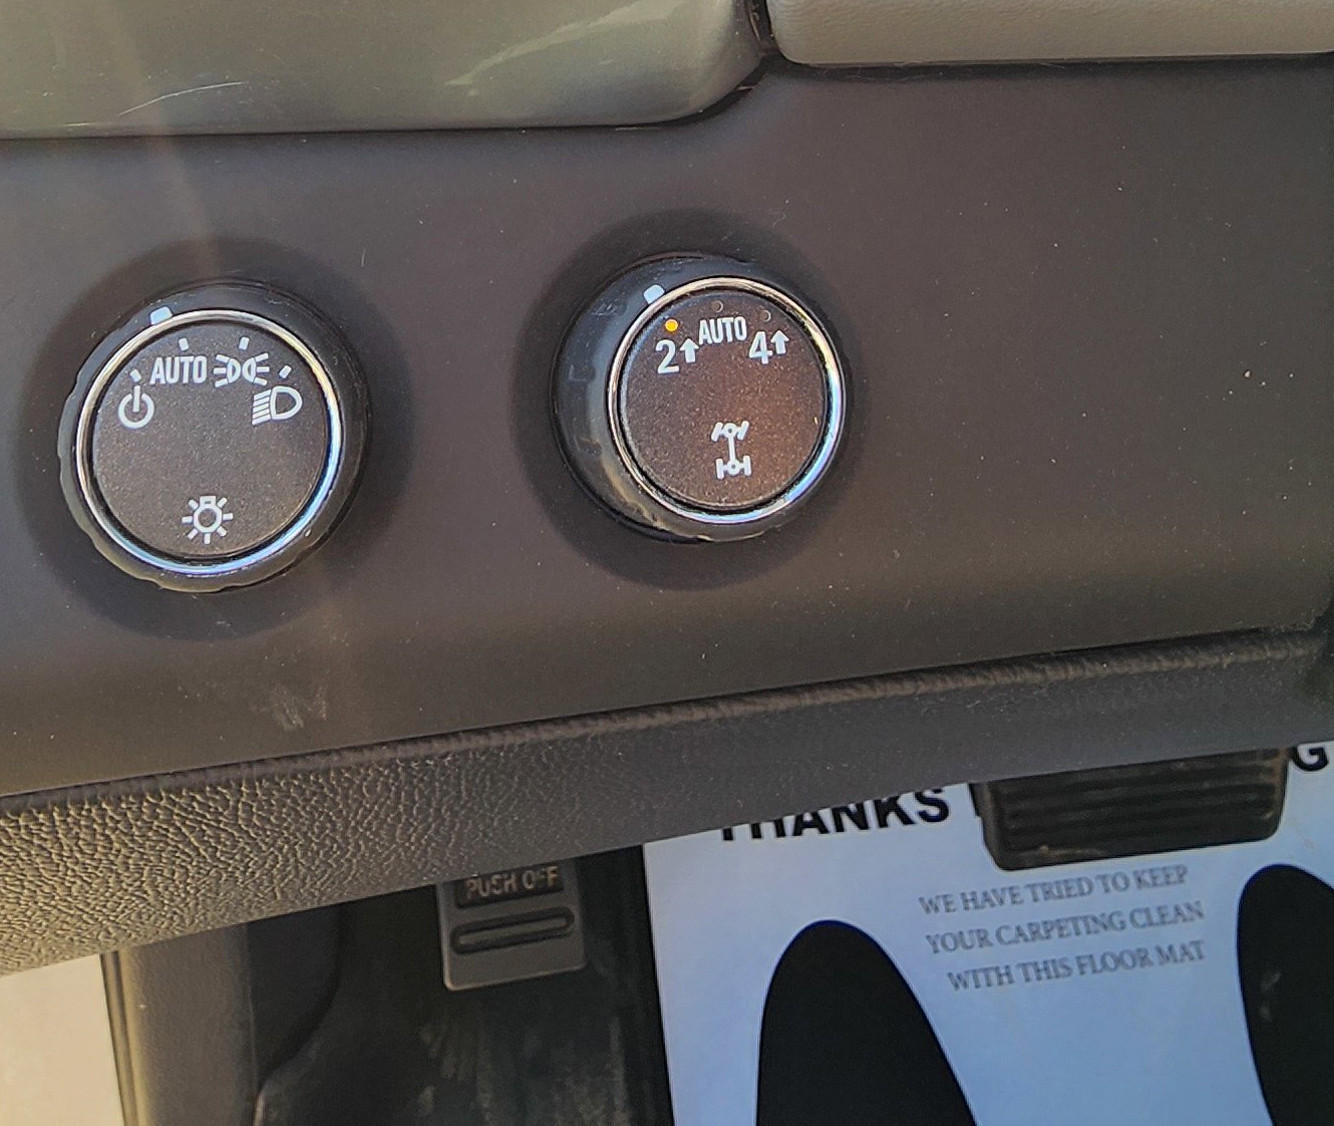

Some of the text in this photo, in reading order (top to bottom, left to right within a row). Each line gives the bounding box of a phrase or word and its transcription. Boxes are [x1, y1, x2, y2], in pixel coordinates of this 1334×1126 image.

[699, 316, 748, 346] AUTO
[748, 330, 774, 365] 4
[149, 355, 208, 385] AUTO
[655, 338, 680, 374] 2
[467, 873, 517, 902] PUSH
[918, 864, 1188, 915] WE HAVE TRIED TO KEEP
[925, 900, 1204, 954] YOUR CARPETING CLEAN
[948, 939, 1205, 991] WITH THIS FLOOR MAT
